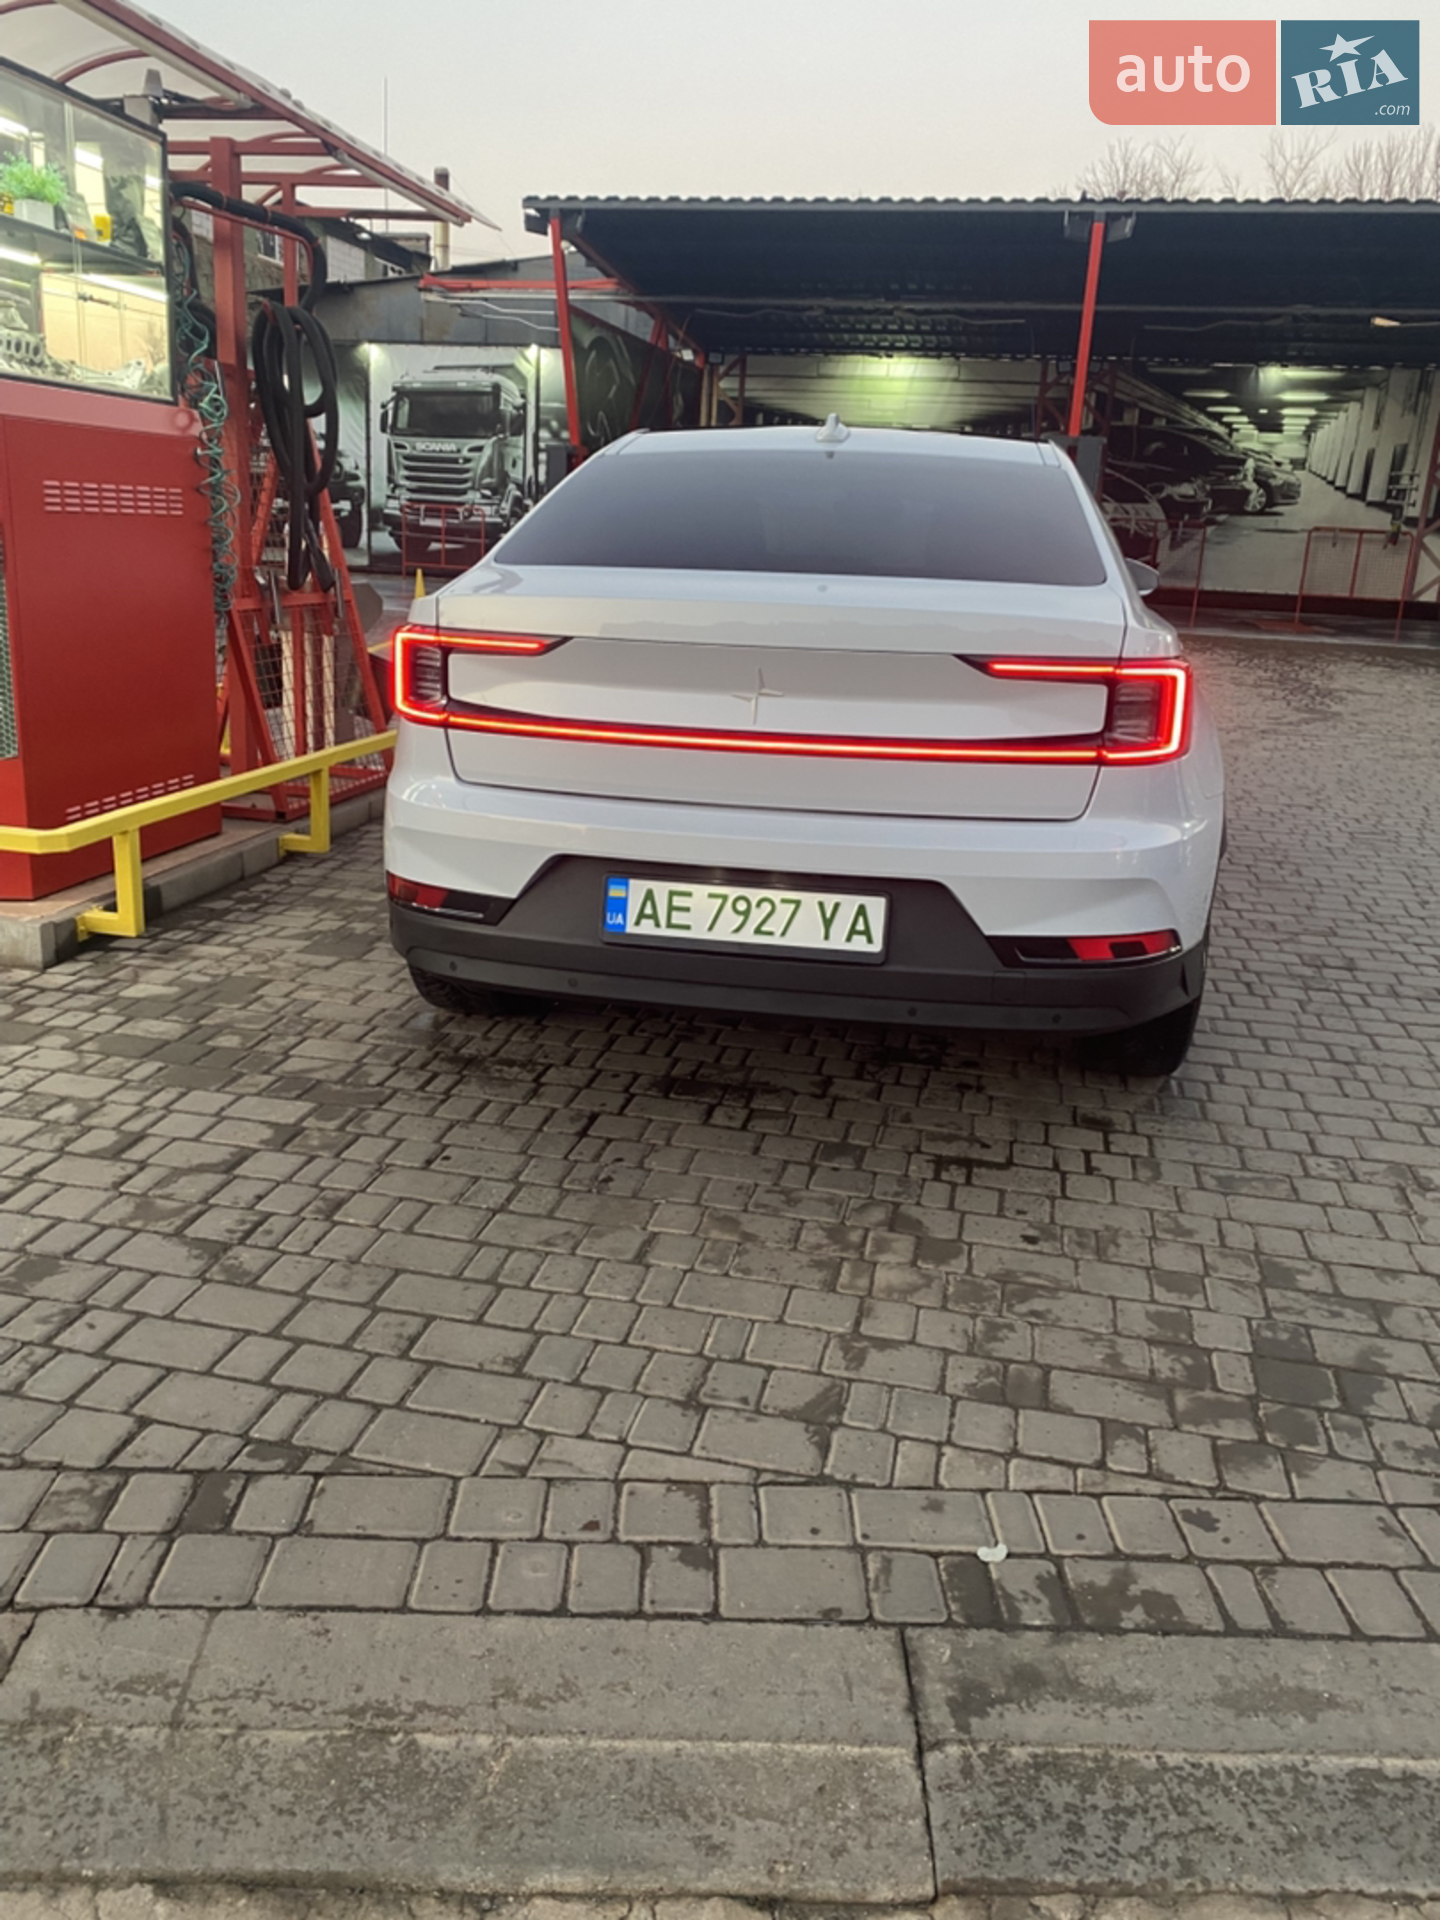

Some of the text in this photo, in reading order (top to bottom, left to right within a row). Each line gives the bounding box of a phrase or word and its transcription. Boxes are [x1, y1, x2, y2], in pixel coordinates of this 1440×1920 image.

[606, 912, 624, 925] UA
[633, 888, 874, 945] AE 7927 YA
